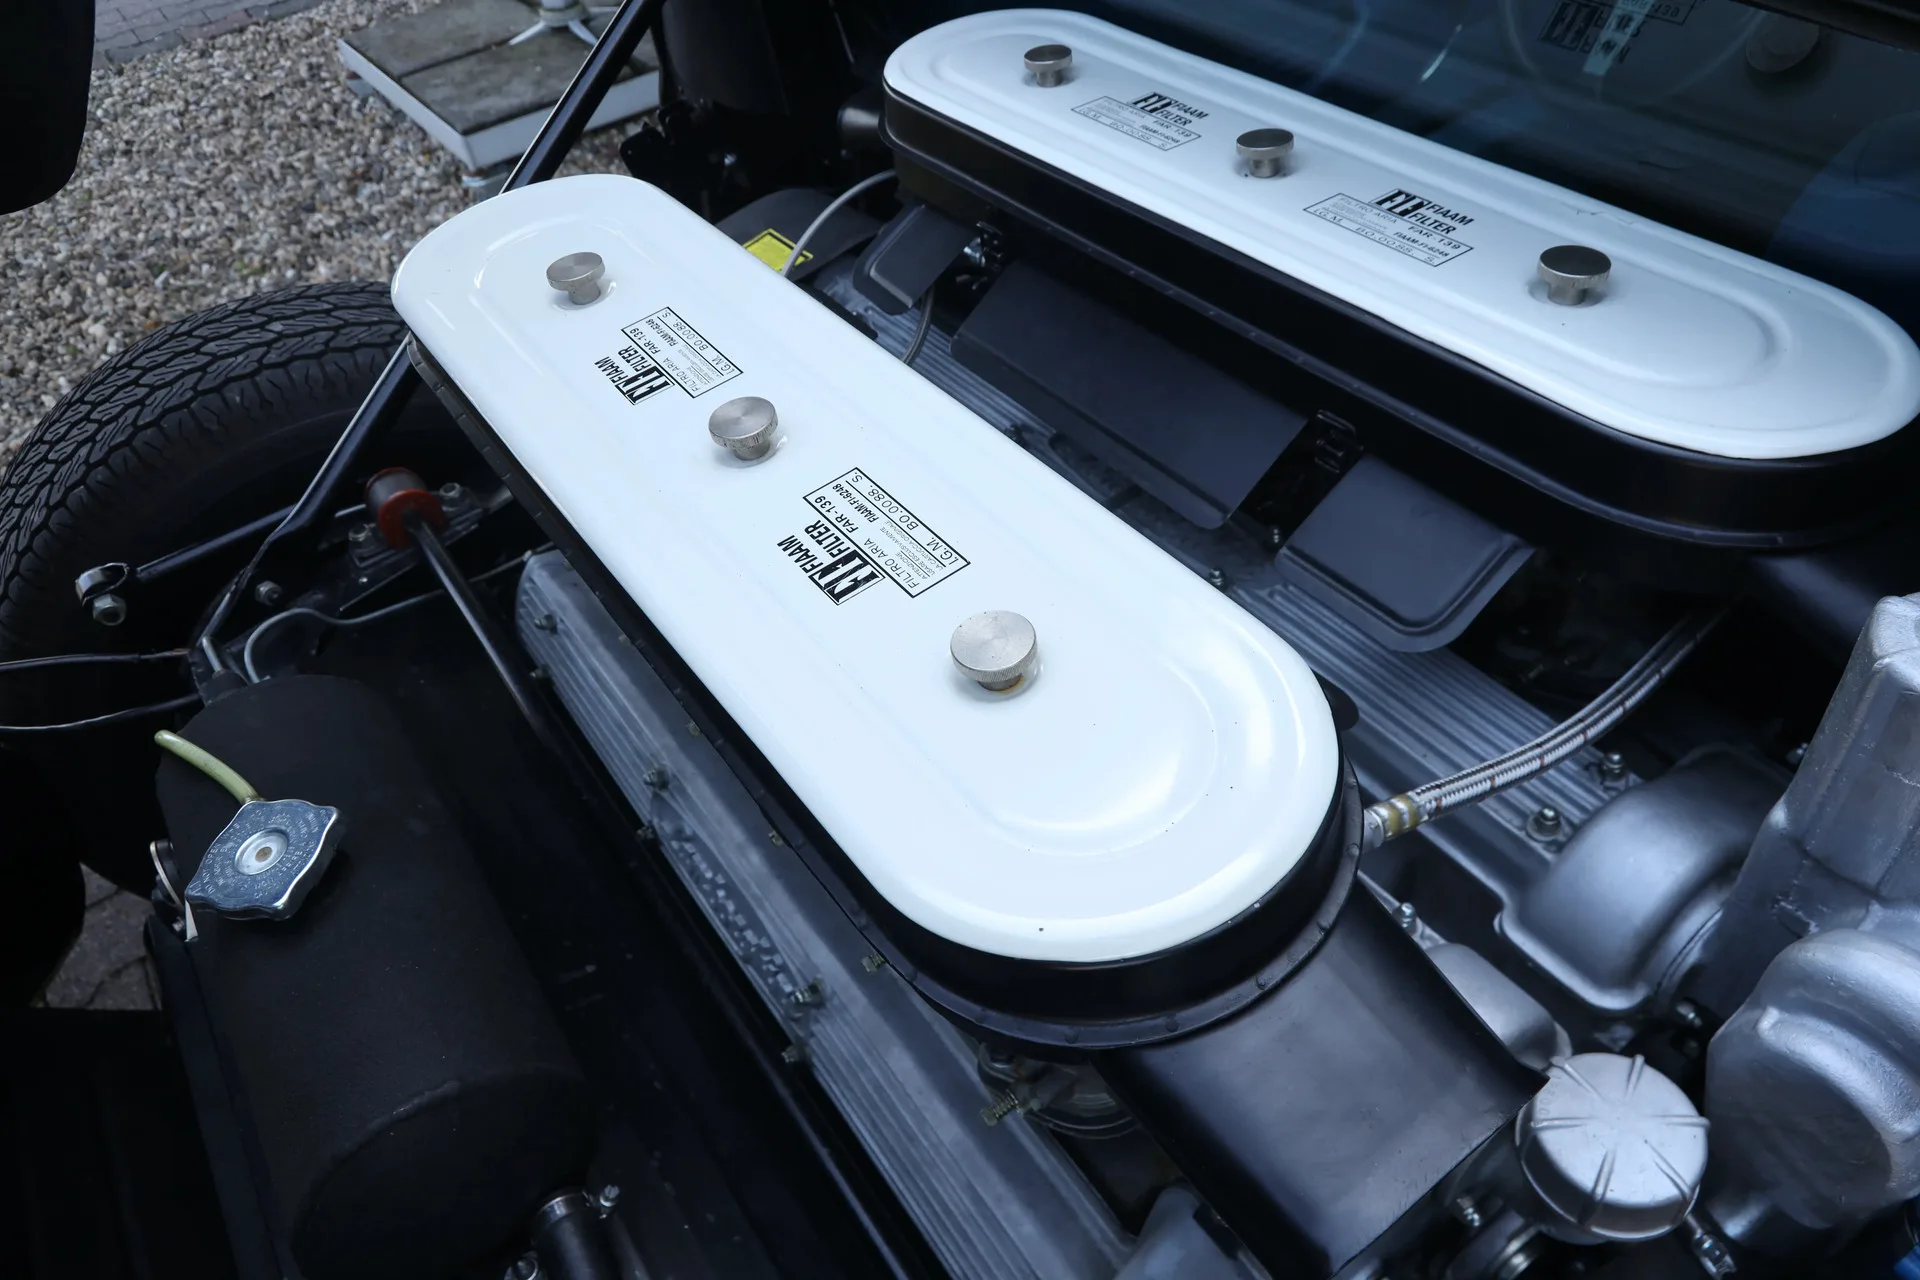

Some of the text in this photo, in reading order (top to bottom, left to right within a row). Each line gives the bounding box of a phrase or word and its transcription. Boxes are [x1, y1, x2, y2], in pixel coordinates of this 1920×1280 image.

[1156, 110, 1192, 126] FILTER
[1409, 212, 1456, 234] FILTER
[1427, 203, 1474, 226] FIAAM
[594, 356, 628, 384] FIAAM
[618, 345, 653, 372] FILTER
[663, 358, 680, 371] ARIA
[676, 371, 700, 392] FILTRO
[804, 520, 850, 557] FILTER
[864, 538, 888, 558] ARIA
[777, 535, 823, 574] FIAAM
[895, 552, 928, 579] ATTENZIONE
[885, 559, 919, 588] FILTRO
